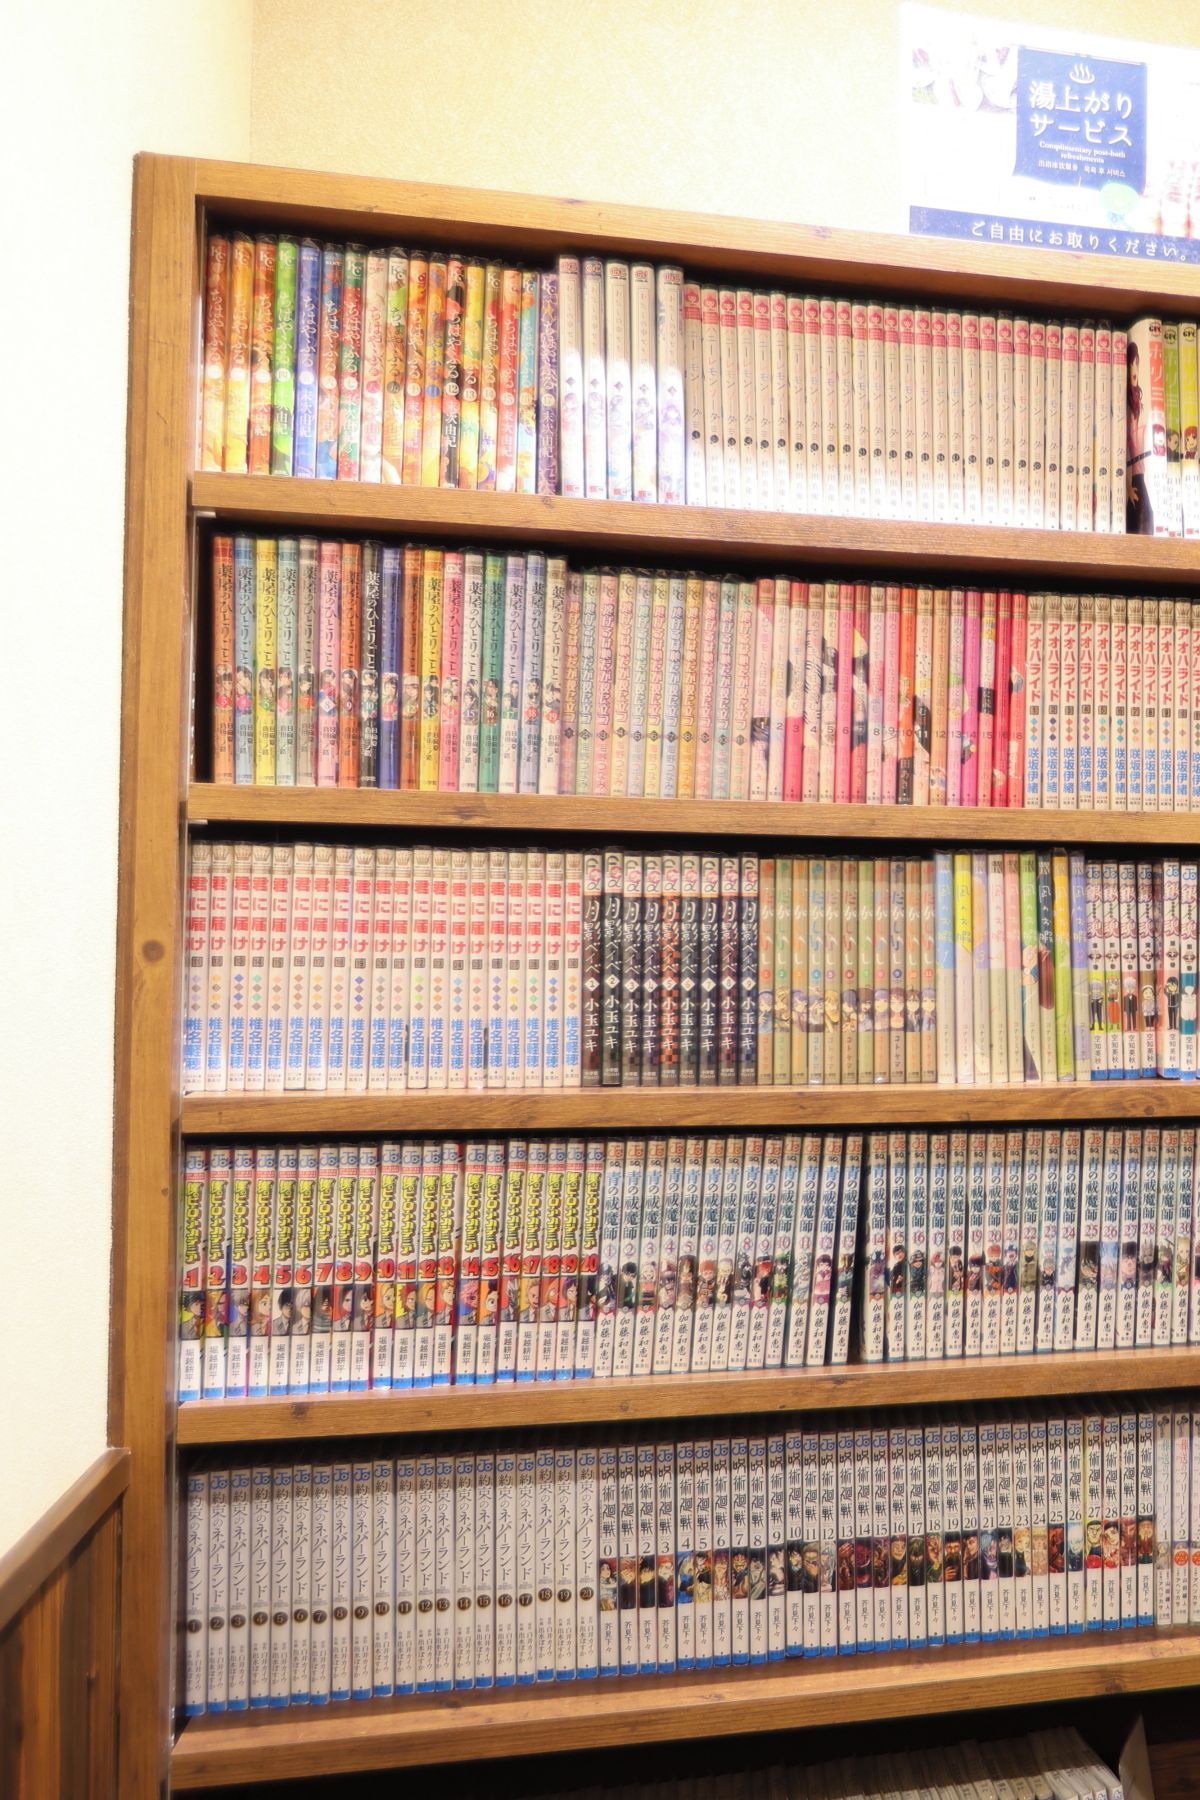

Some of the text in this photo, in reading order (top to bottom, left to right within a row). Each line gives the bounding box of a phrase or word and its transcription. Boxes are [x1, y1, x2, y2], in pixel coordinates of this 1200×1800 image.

[1028, 80, 1133, 120] 湯上がり
[1030, 113, 1133, 146] サービス
[1039, 140, 1091, 156] Complimentary
[970, 220, 1187, 261] ご自由にお取りください。
[1097, 624, 1109, 703] アオハライド
[1114, 625, 1126, 704] アオハライド
[1145, 627, 1157, 705] アオハライド
[293, 877, 311, 951] 君に届け
[414, 880, 429, 953] 君に届け
[471, 882, 485, 955] 君に届け
[527, 882, 542, 955] 君に届け
[566, 882, 581, 955] 君に届け
[208, 1266, 224, 1286] 2
[232, 1265, 248, 1285] 3
[253, 1265, 270, 1284] 4
[275, 1265, 291, 1284] 5
[316, 1263, 334, 1282] 7
[355, 1261, 372, 1281] 9
[640, 1466, 655, 1536] 呪術廻戦
[714, 1459, 730, 1529] 呪術廻戦
[733, 1459, 747, 1529] 呪術廻戦
[770, 1455, 785, 1523] 呪術廻戦
[603, 1545, 612, 1556] 0
[642, 1543, 651, 1554] 2
[682, 1537, 691, 1549] 4
[717, 1536, 726, 1547] 6
[735, 1533, 744, 1545] 7
[772, 1531, 781, 1543] 9
